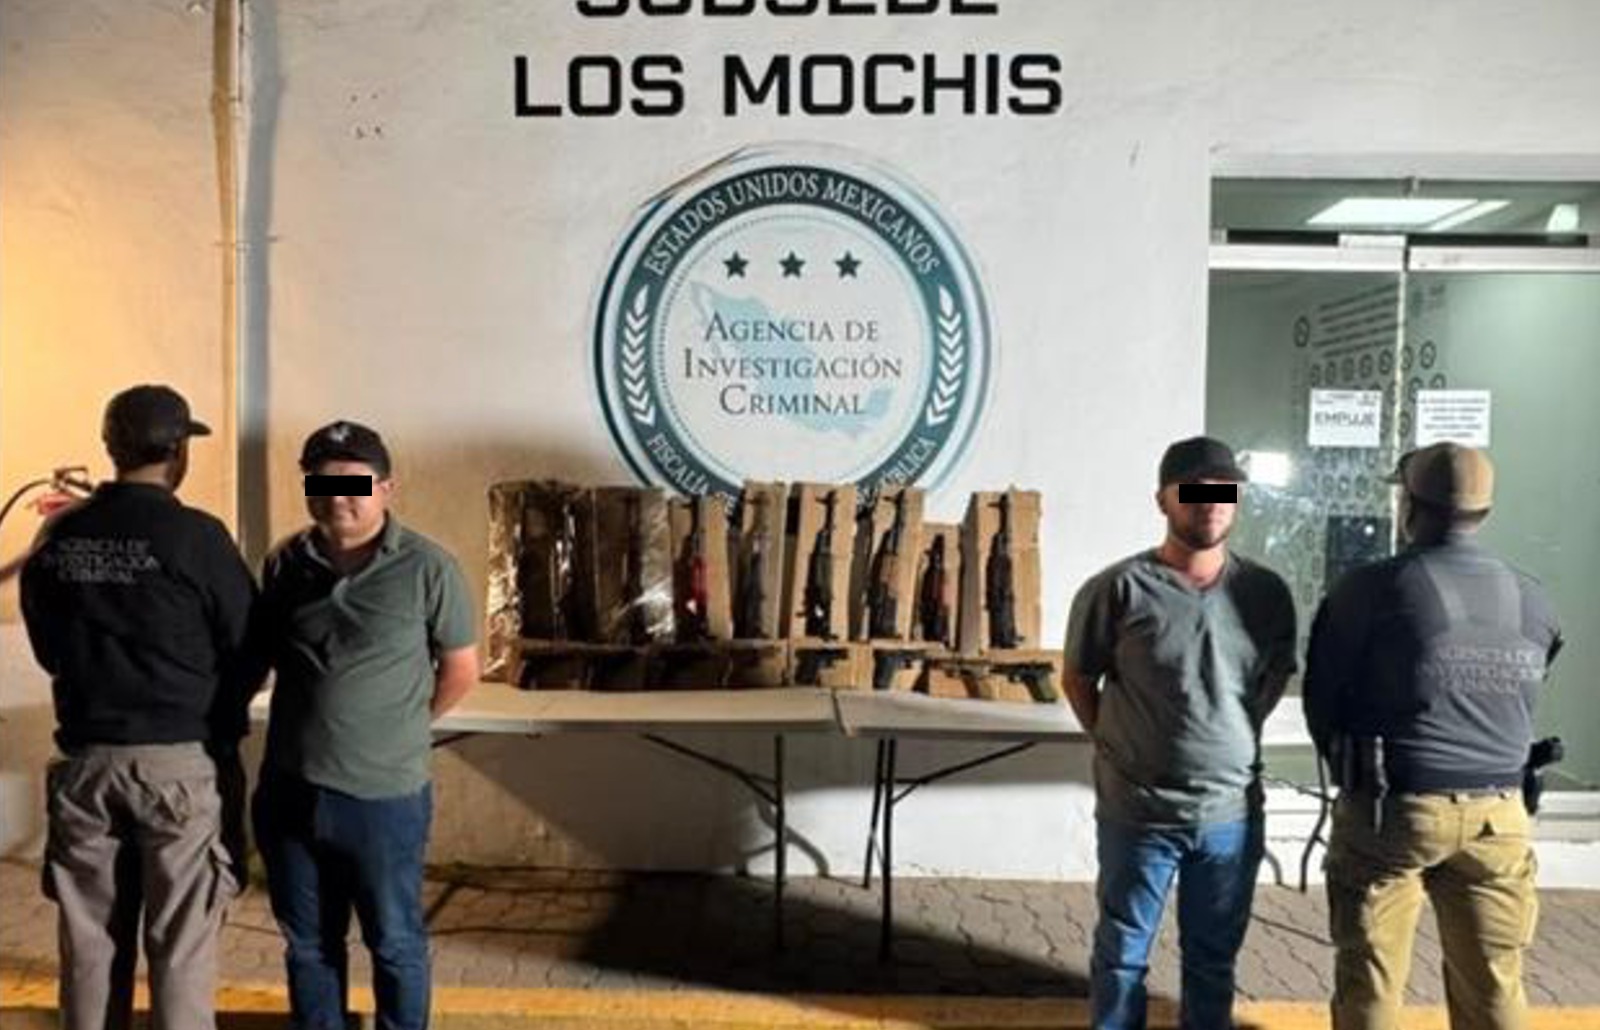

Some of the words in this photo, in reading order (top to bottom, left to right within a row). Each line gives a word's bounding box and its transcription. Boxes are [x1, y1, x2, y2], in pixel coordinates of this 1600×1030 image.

[514, 54, 684, 117] LOS
[723, 53, 1063, 117] MOCHIS
[643, 190, 729, 276] ESTADOS
[726, 171, 819, 206] UNIDOS
[822, 176, 941, 275] MEXICANOS
[704, 310, 834, 342] AGENCIA
[845, 320, 879, 342] DE
[684, 346, 902, 379] INVESTIGACIÓN
[718, 384, 867, 415] CRIMINAL
